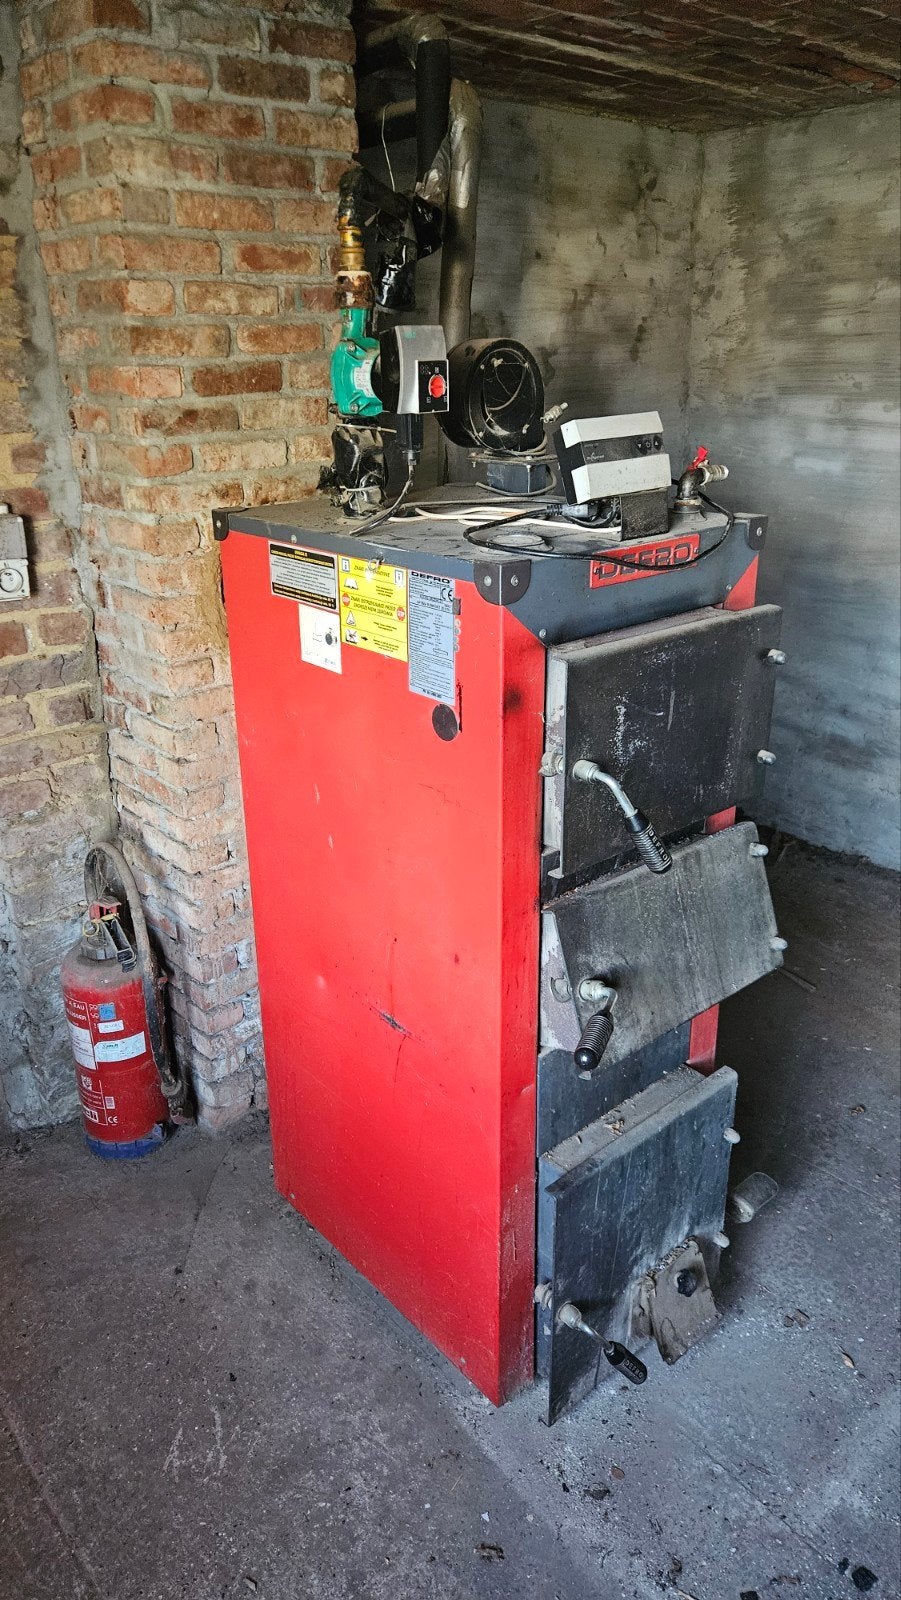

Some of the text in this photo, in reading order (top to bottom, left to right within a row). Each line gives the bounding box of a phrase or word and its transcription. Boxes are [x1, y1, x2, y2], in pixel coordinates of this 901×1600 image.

[411, 571, 451, 584] DEFRO
[648, 829, 668, 861] DEFRO
[623, 1359, 644, 1378] DEFRO
